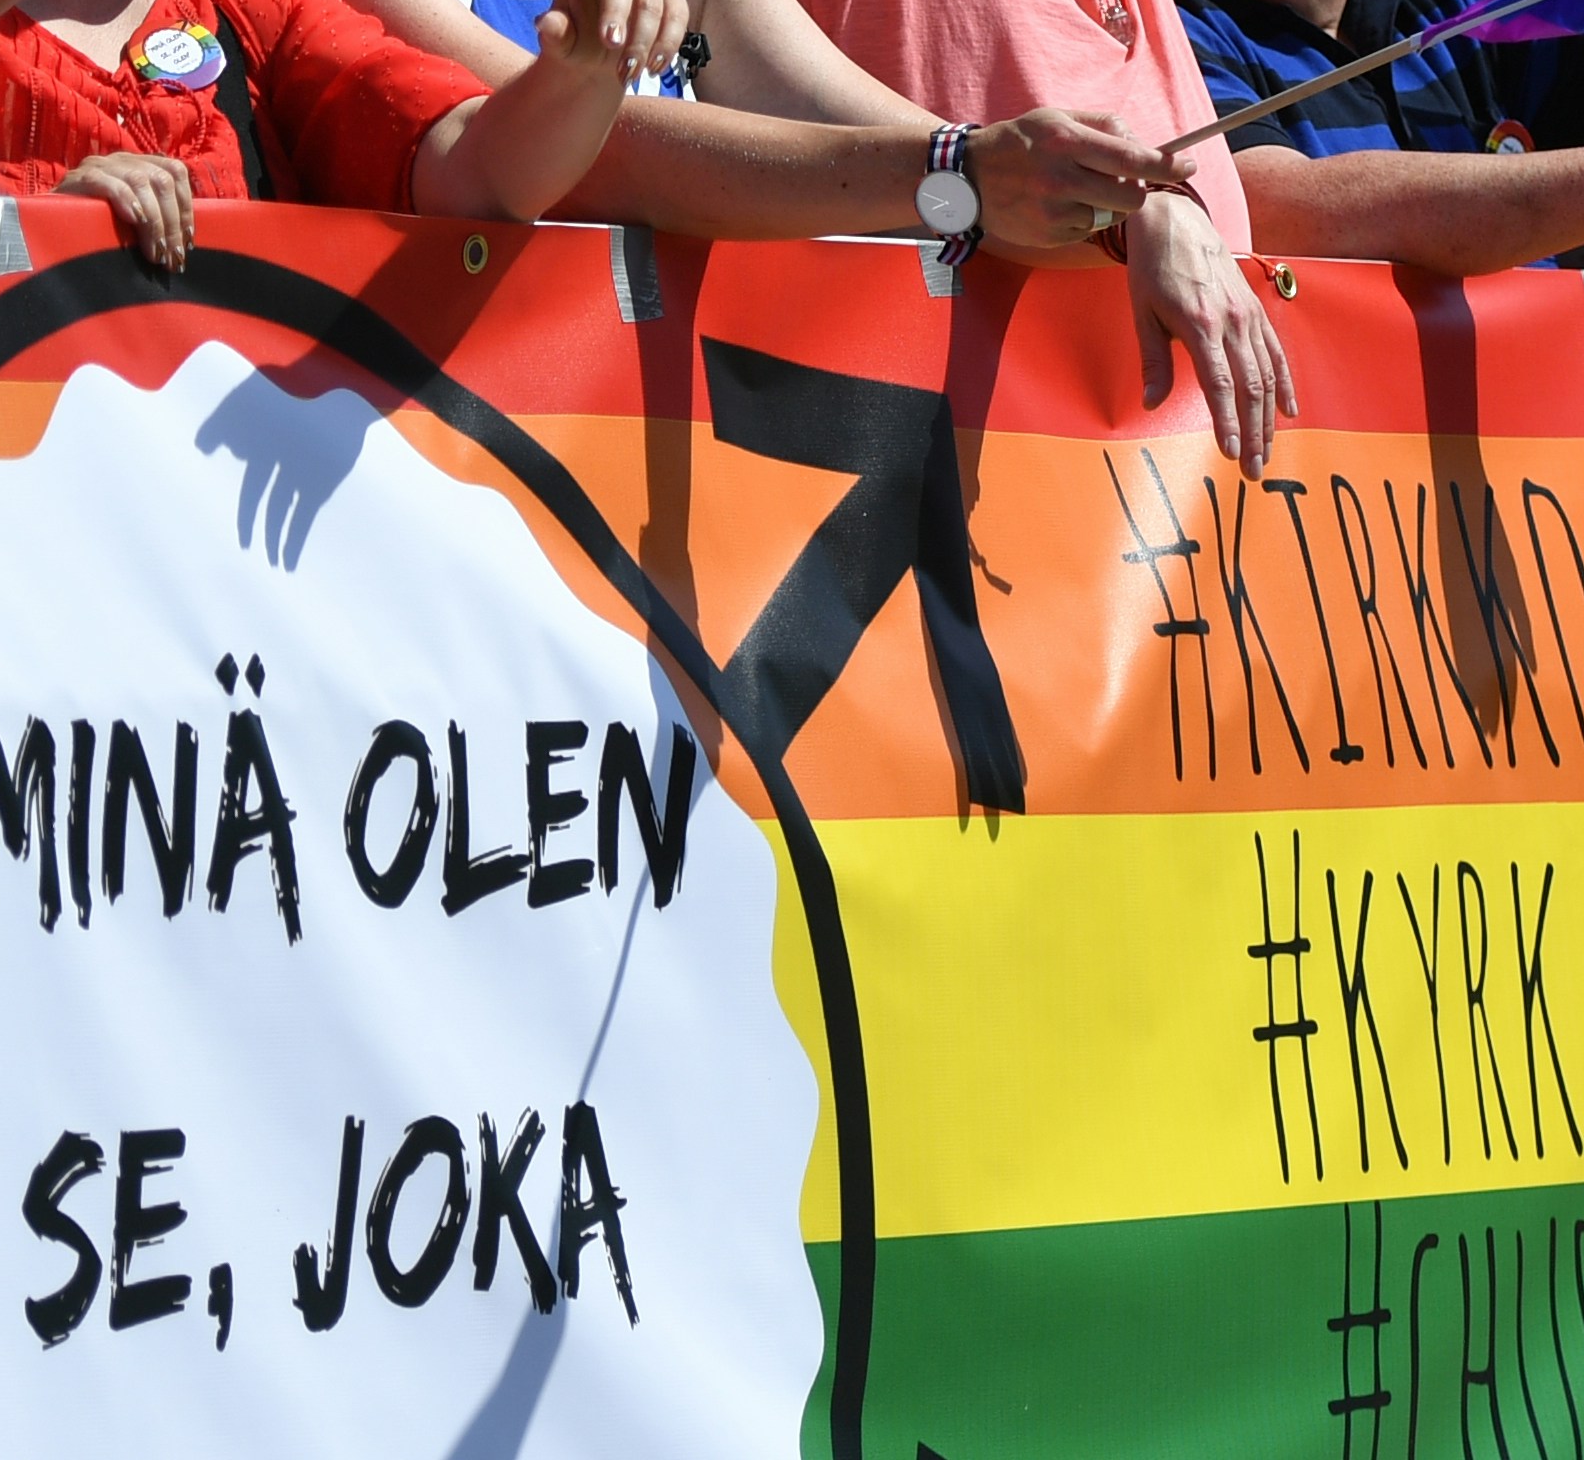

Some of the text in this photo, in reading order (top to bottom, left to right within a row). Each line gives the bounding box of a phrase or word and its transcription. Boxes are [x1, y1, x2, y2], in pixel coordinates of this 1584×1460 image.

[342, 719, 697, 916] OLEN
[22, 1100, 641, 1352] SE, JOKA
